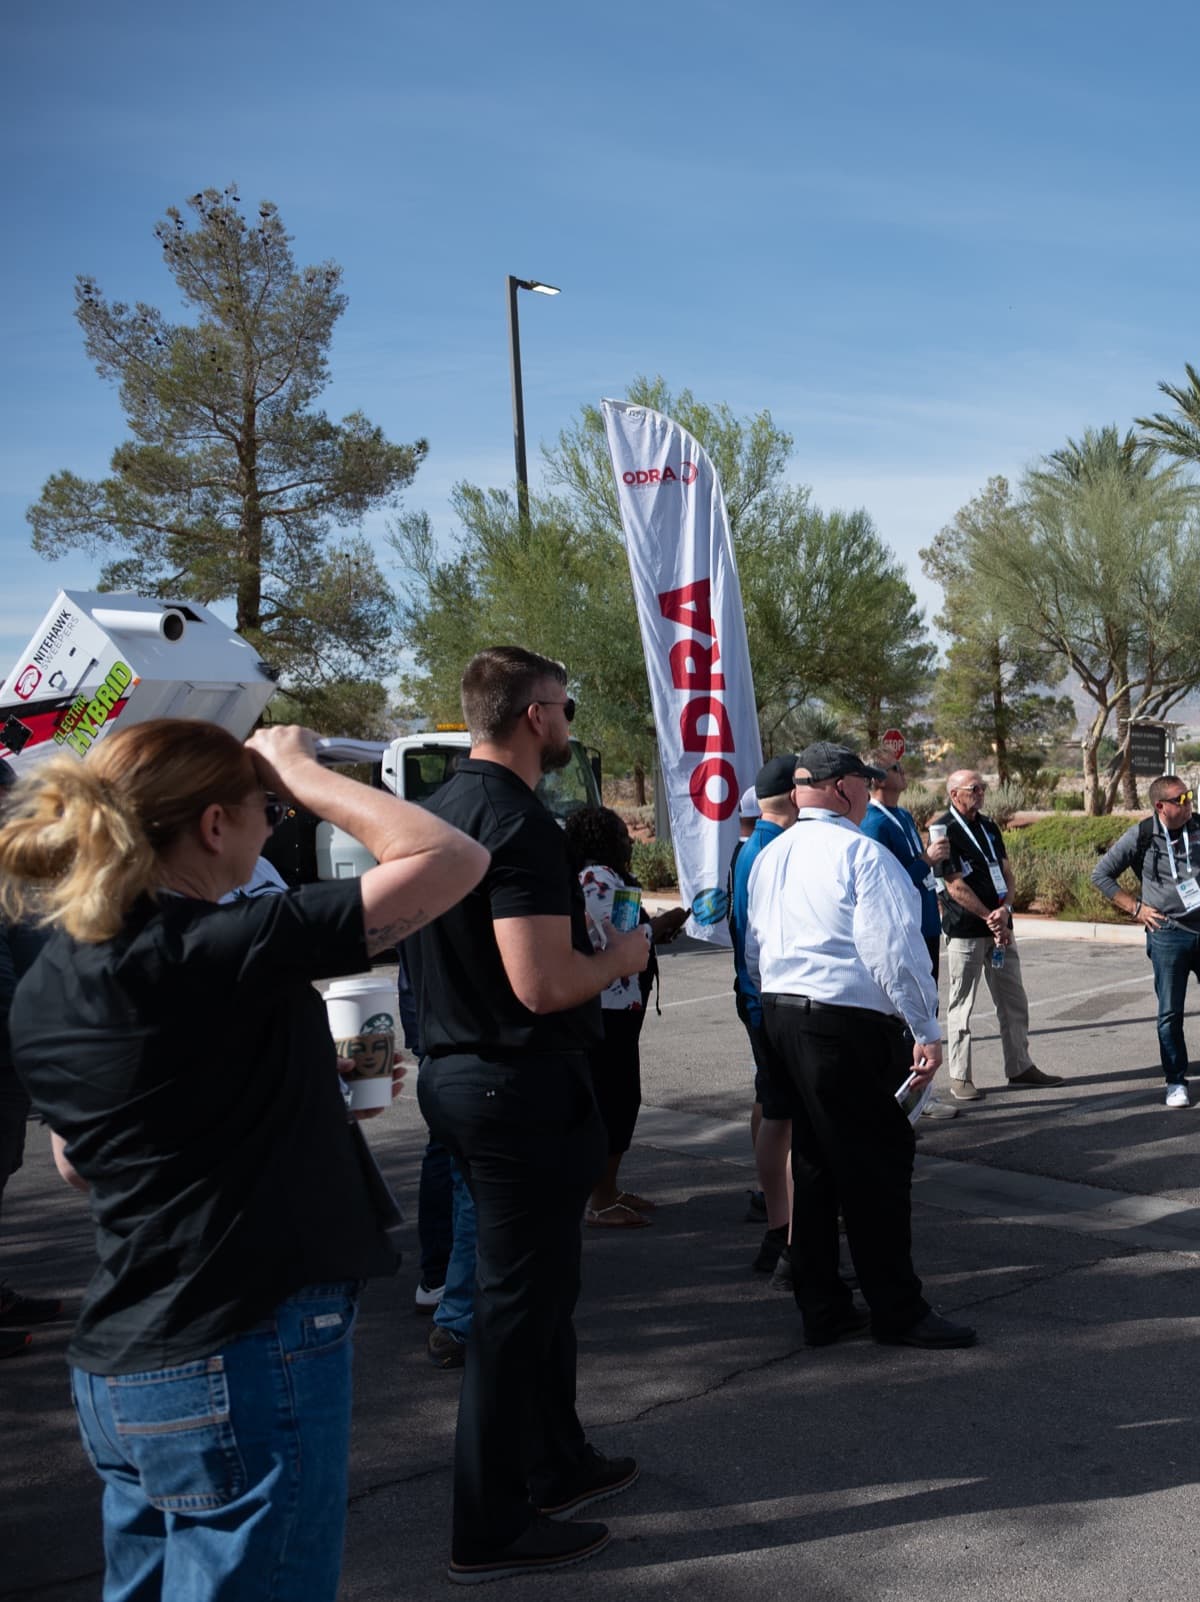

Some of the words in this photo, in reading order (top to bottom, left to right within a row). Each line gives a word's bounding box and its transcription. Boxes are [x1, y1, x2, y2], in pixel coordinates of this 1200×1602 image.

[622, 466, 677, 485] ODRA
[33, 608, 72, 665] NITEHAWK
[41, 616, 81, 669] SWEEPERS
[53, 692, 88, 745] ELECTRIC
[67, 660, 134, 757] HYBRID
[658, 577, 740, 821] ODRA
